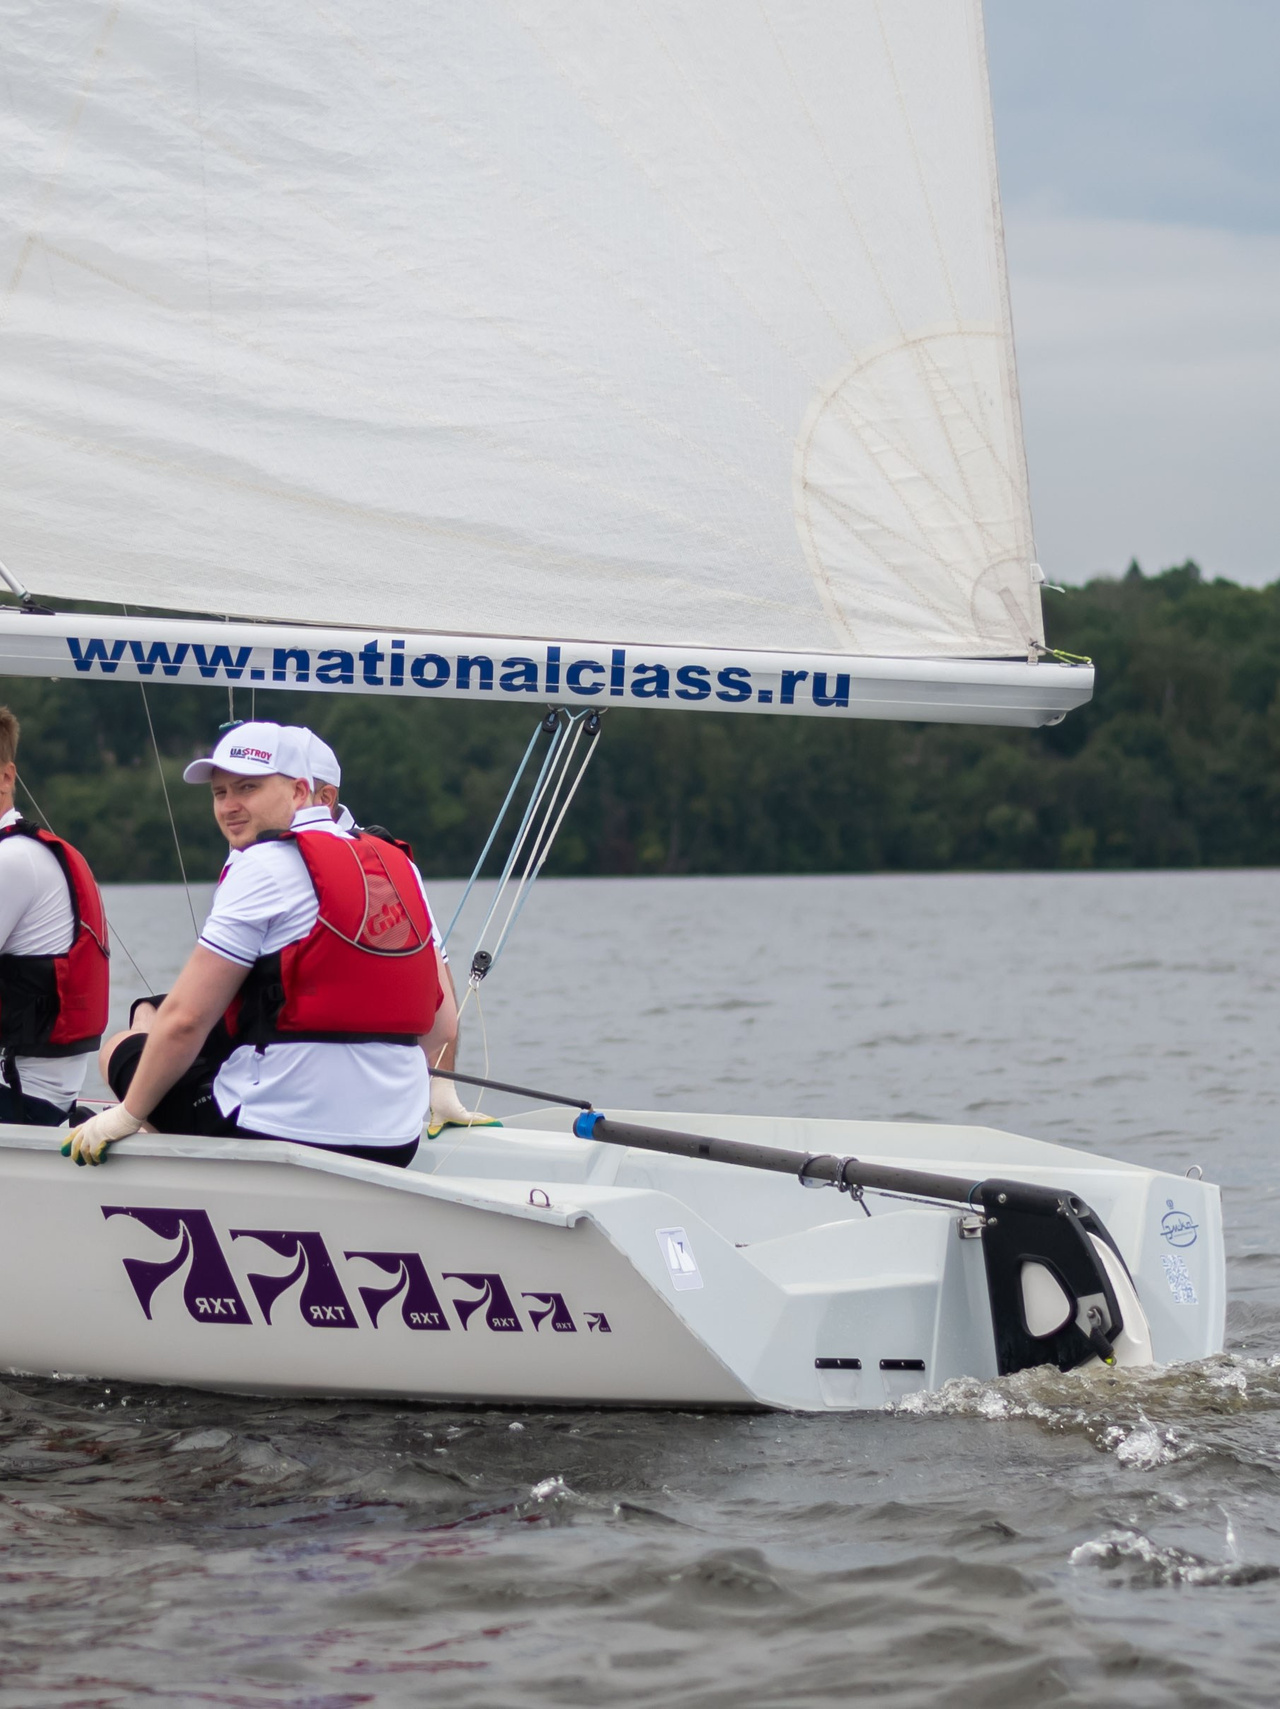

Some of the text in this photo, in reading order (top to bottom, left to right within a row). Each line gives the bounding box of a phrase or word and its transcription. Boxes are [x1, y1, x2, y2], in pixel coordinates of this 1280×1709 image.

[66, 637, 851, 708] www.nationalclass.ru
[195, 1297, 237, 1315] ЯХТ
[309, 1305, 346, 1321] ЯХТ
[410, 1312, 440, 1325] ЯХТ
